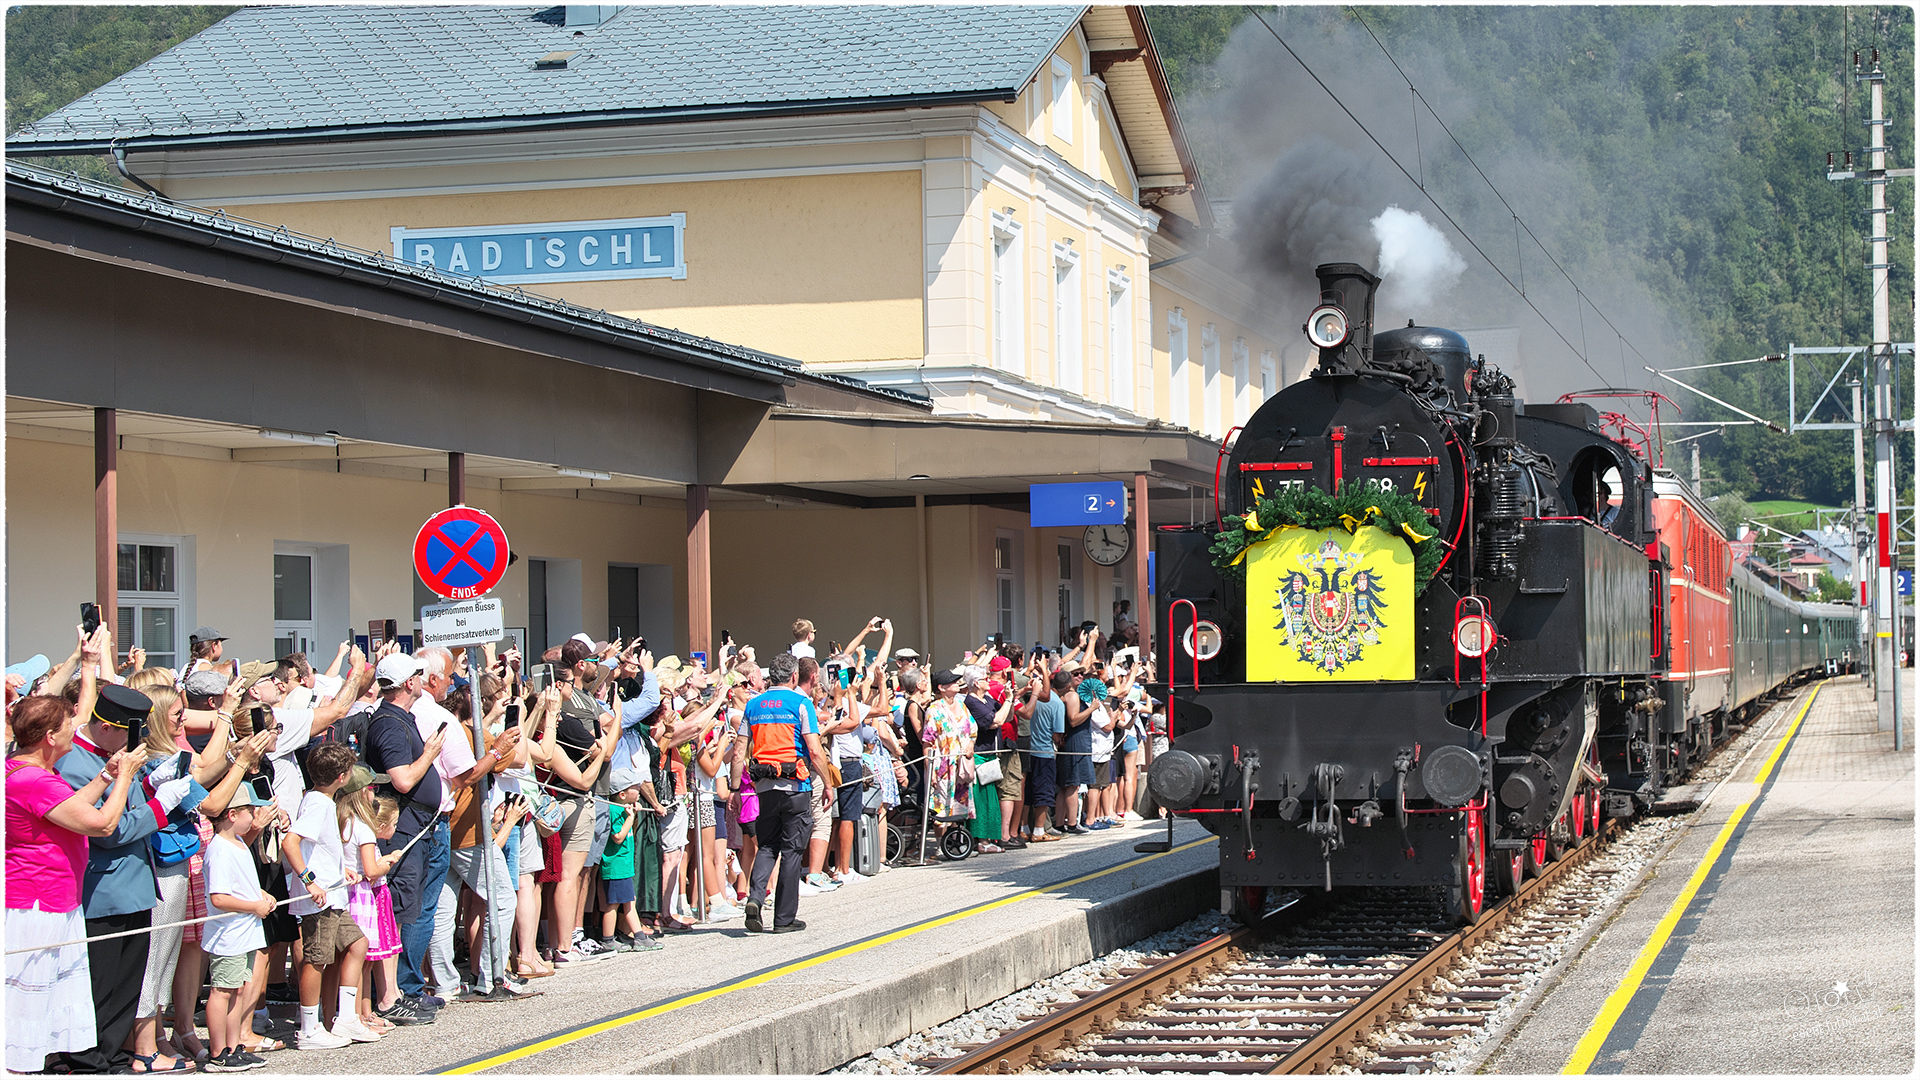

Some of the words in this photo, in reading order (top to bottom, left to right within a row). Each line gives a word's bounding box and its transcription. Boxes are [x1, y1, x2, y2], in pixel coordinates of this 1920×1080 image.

[415, 241, 502, 271] BAD
[525, 233, 662, 269] ISCHL
[1088, 496, 1098, 511] 2
[1898, 575, 1905, 591] 2
[451, 586, 478, 598] ENDE
[425, 605, 474, 618] ausgenommen
[475, 603, 495, 612] Busse
[455, 617, 467, 627] bei
[424, 627, 500, 643] Schienenersatzverkehr
[1826, 659, 1838, 674] H
